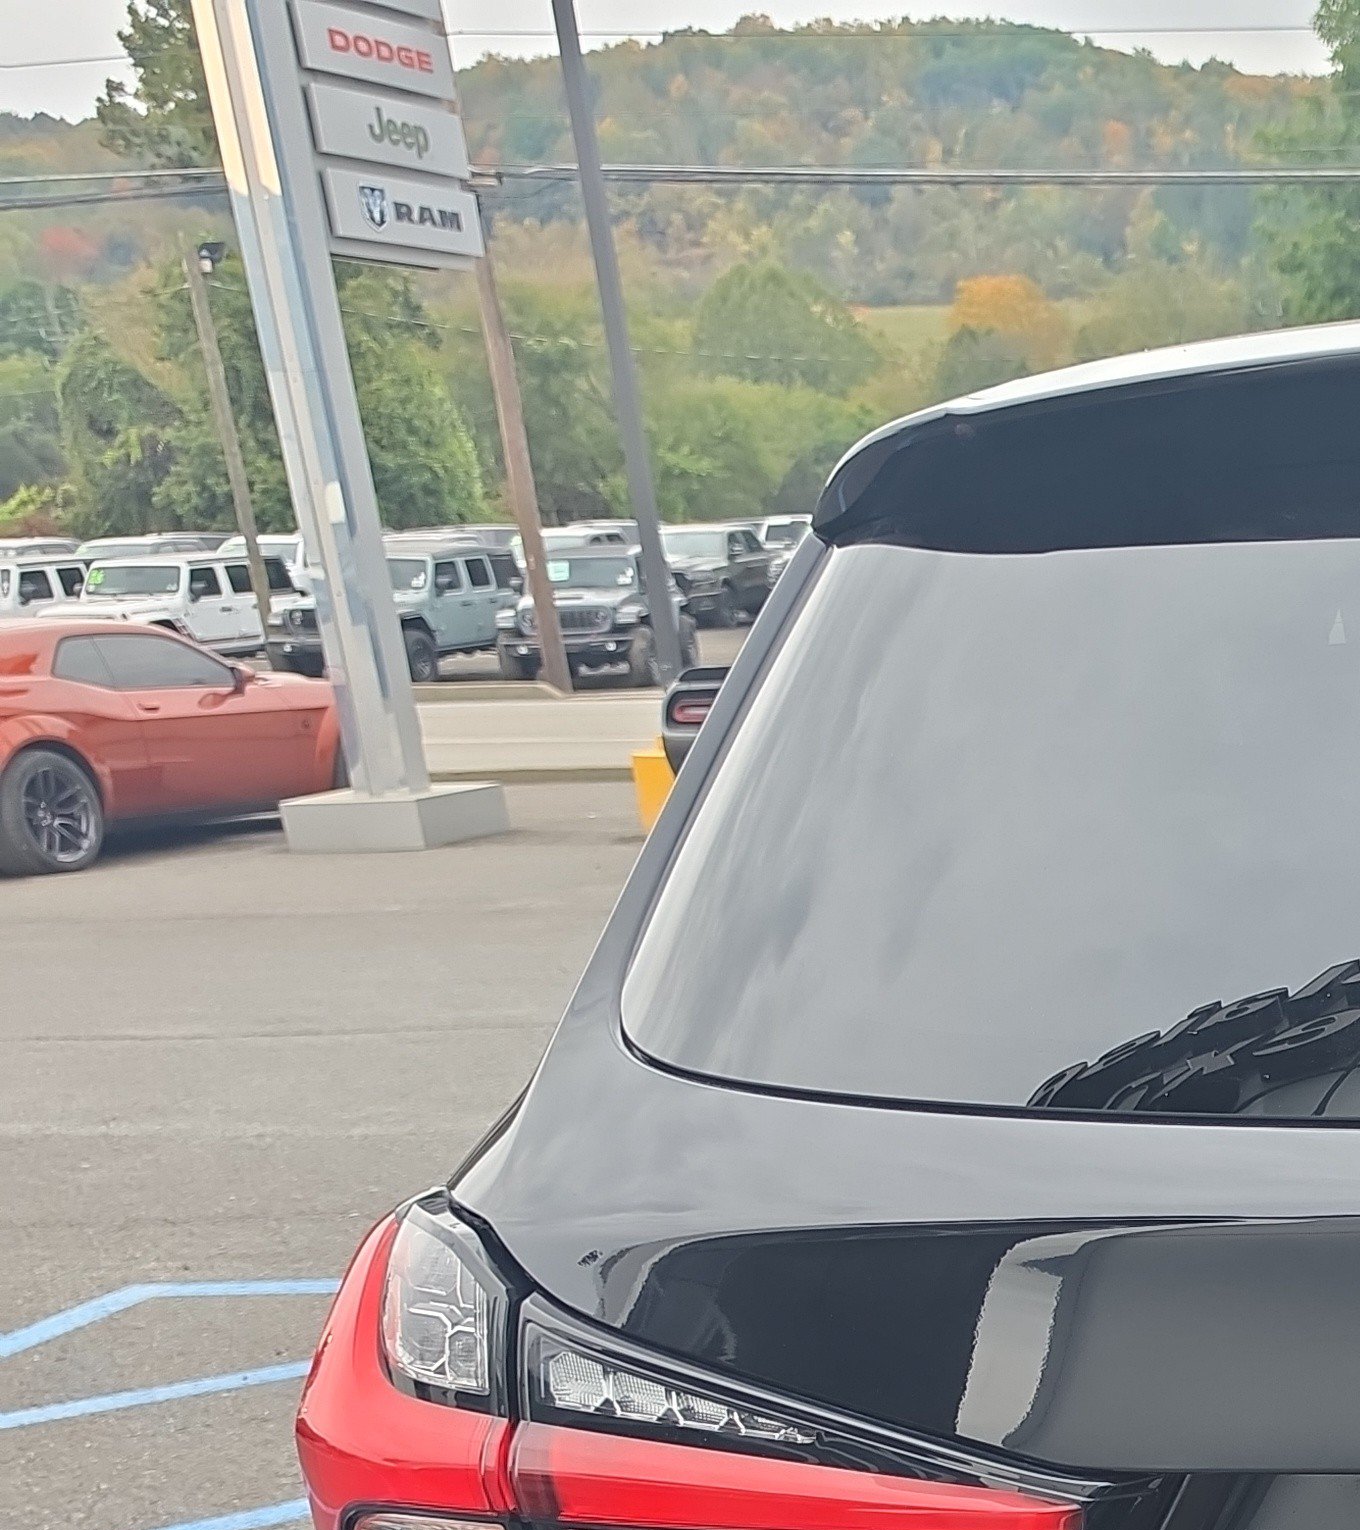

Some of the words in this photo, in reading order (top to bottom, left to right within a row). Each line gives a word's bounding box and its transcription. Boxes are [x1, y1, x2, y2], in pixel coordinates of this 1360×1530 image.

[328, 28, 434, 74] DODGE
[368, 106, 430, 159] Jeep
[393, 202, 462, 232] RAM
